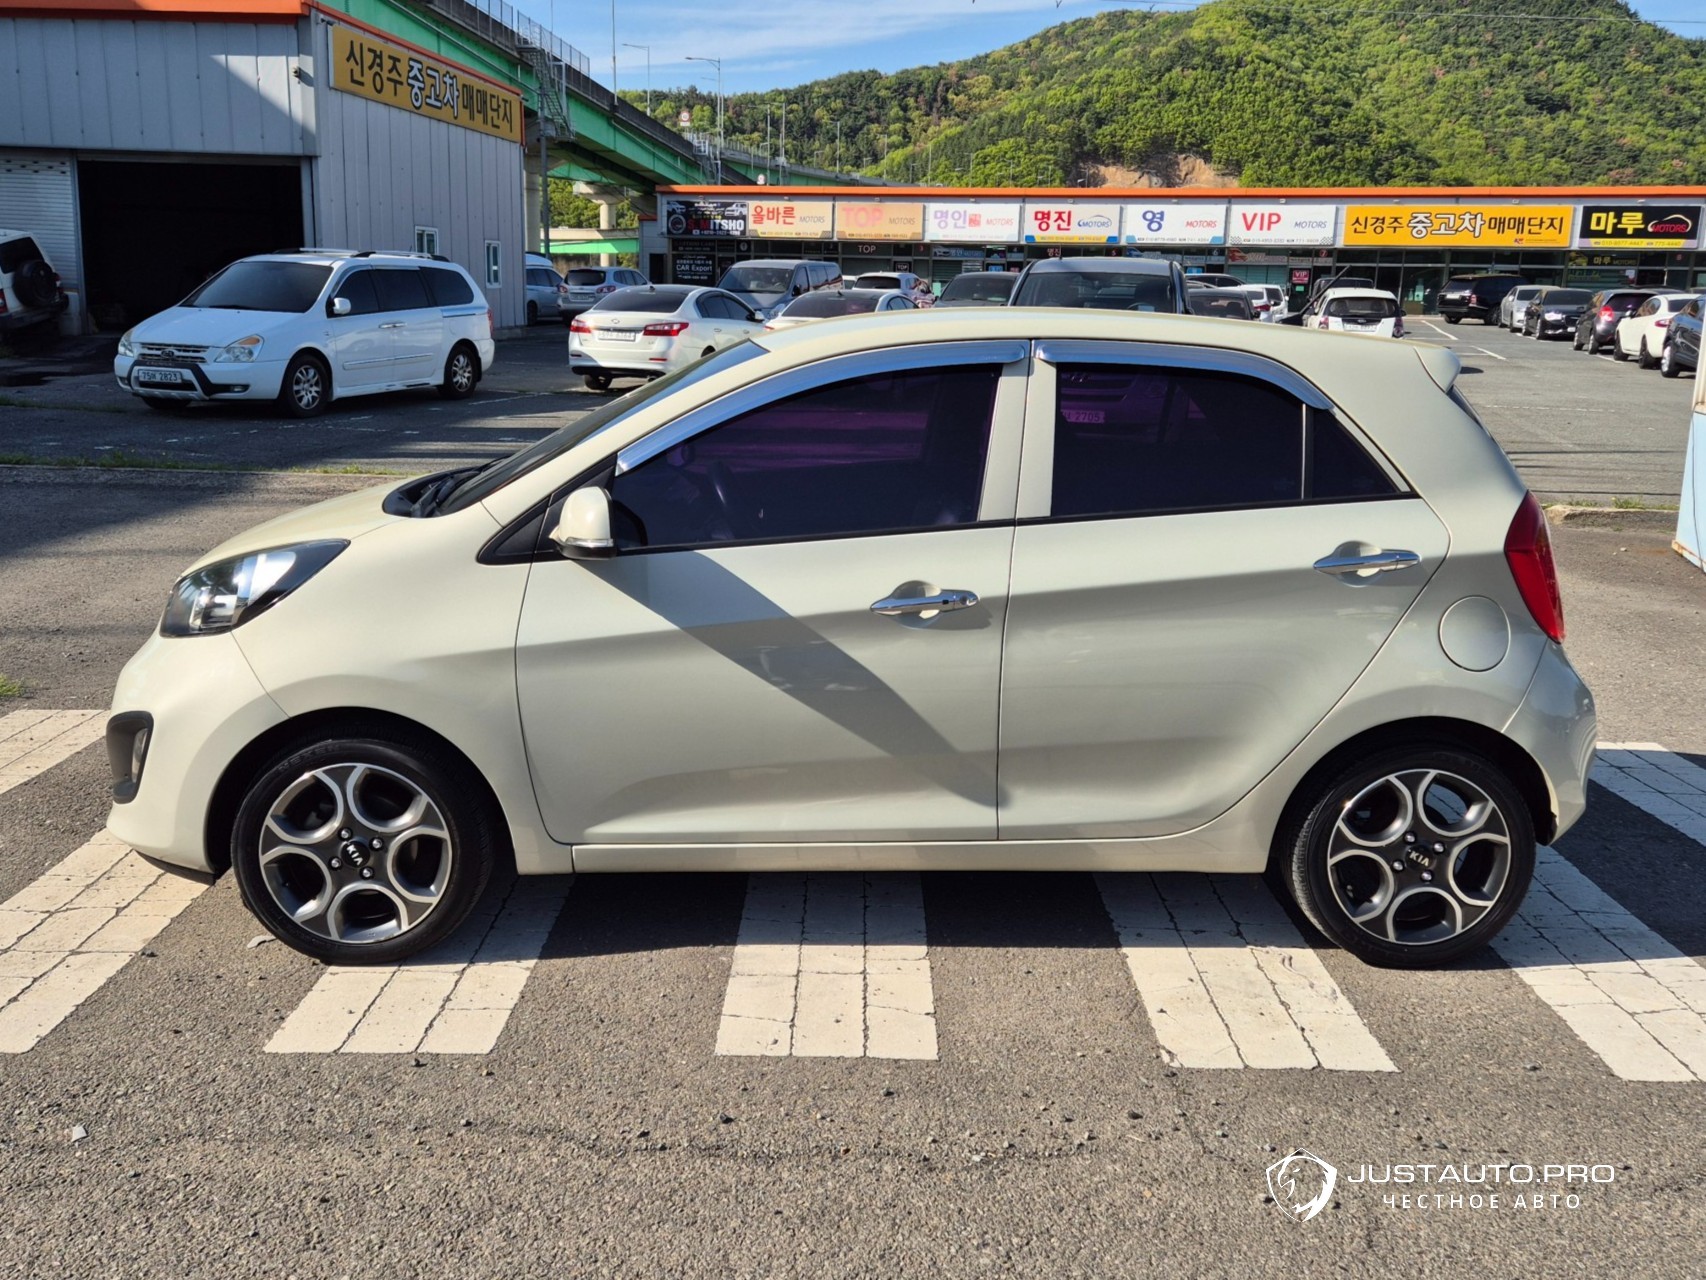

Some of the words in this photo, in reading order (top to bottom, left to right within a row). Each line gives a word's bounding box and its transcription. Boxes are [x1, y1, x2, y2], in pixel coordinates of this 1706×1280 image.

[346, 40, 404, 97] 신경주
[406, 57, 460, 119] 중고차
[461, 83, 513, 133] 매매단지
[751, 205, 796, 225] 올바른
[842, 206, 885, 228] TOP
[888, 217, 916, 225] MOTORS
[933, 209, 967, 230] 명인
[985, 218, 1014, 226] MOTORS
[1034, 210, 1072, 231] 명진
[1082, 220, 1110, 228] MOTORS
[1142, 210, 1165, 232] 영
[1185, 220, 1217, 228] MOTORS
[1242, 212, 1282, 231] VIP
[1293, 221, 1328, 229] MOTORS
[1351, 216, 1404, 235] 신경주
[1407, 211, 1486, 239] 중고차
[1487, 216, 1564, 235] 매매단지
[1590, 211, 1645, 235] 마루
[1651, 223, 1687, 233] MOTORS
[857, 245, 876, 253] TOP
[691, 264, 713, 272] Export
[1593, 256, 1611, 265] 마루
[159, 372, 178, 381] 2823
[1074, 411, 1101, 422] 2705
[346, 844, 363, 866] KIA
[1409, 850, 1430, 867] KIA
